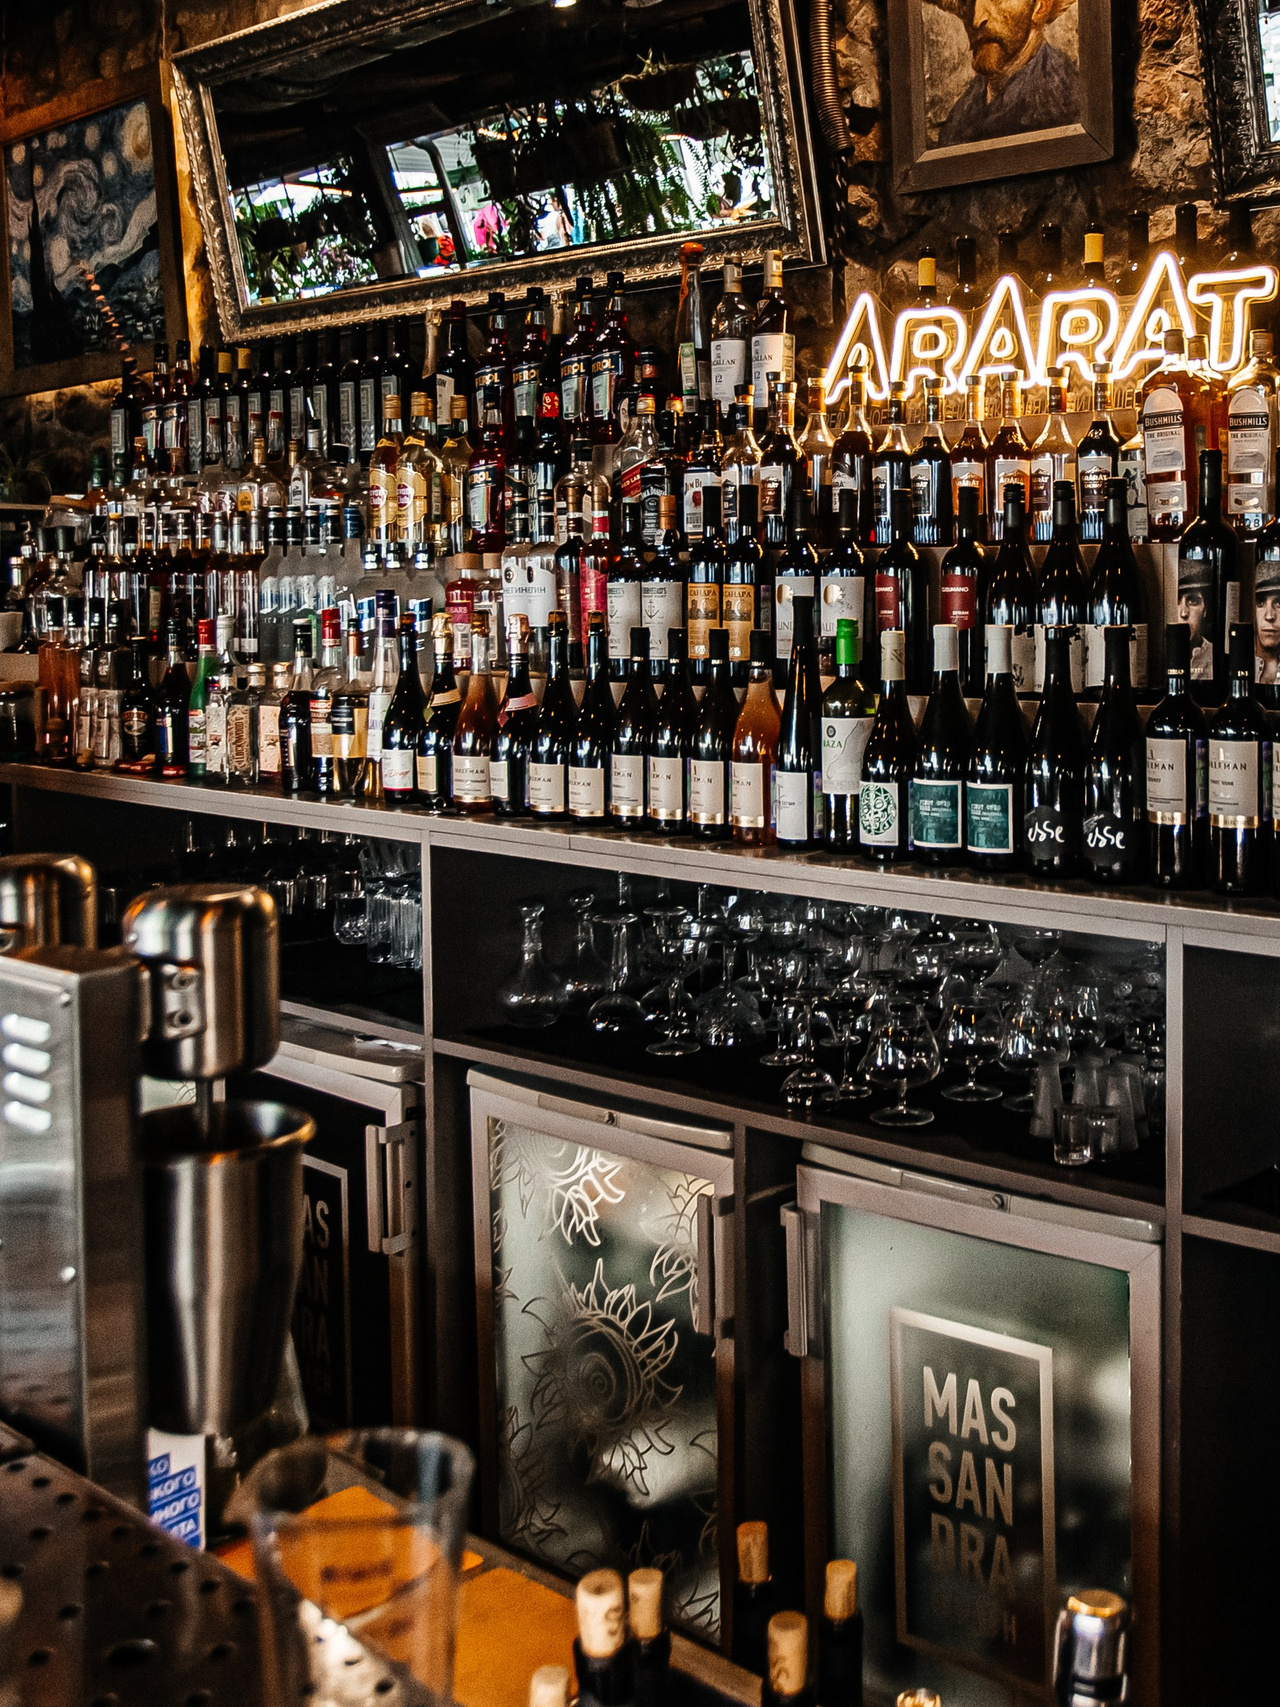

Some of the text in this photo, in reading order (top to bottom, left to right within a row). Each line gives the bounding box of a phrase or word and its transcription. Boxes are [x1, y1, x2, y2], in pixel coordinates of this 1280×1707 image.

[824, 251, 1280, 405] ARARAT
[561, 362, 586, 377] EROL
[592, 358, 615, 373] EROL
[712, 358, 736, 367] CALLAN
[475, 371, 500, 387] EROL
[714, 375, 723, 383] 12
[1144, 414, 1183, 427] BUSHMILLS
[1229, 416, 1268, 427] BUSHMILLS
[1156, 430, 1181, 438] ORIGINAL
[824, 740, 842, 748] AZA
[303, 1193, 330, 1250] AS
[302, 1254, 330, 1308] AN
[922, 1364, 1017, 1453] MAS
[927, 1441, 1014, 1528] SAN
[930, 1511, 1015, 1600] DRA
